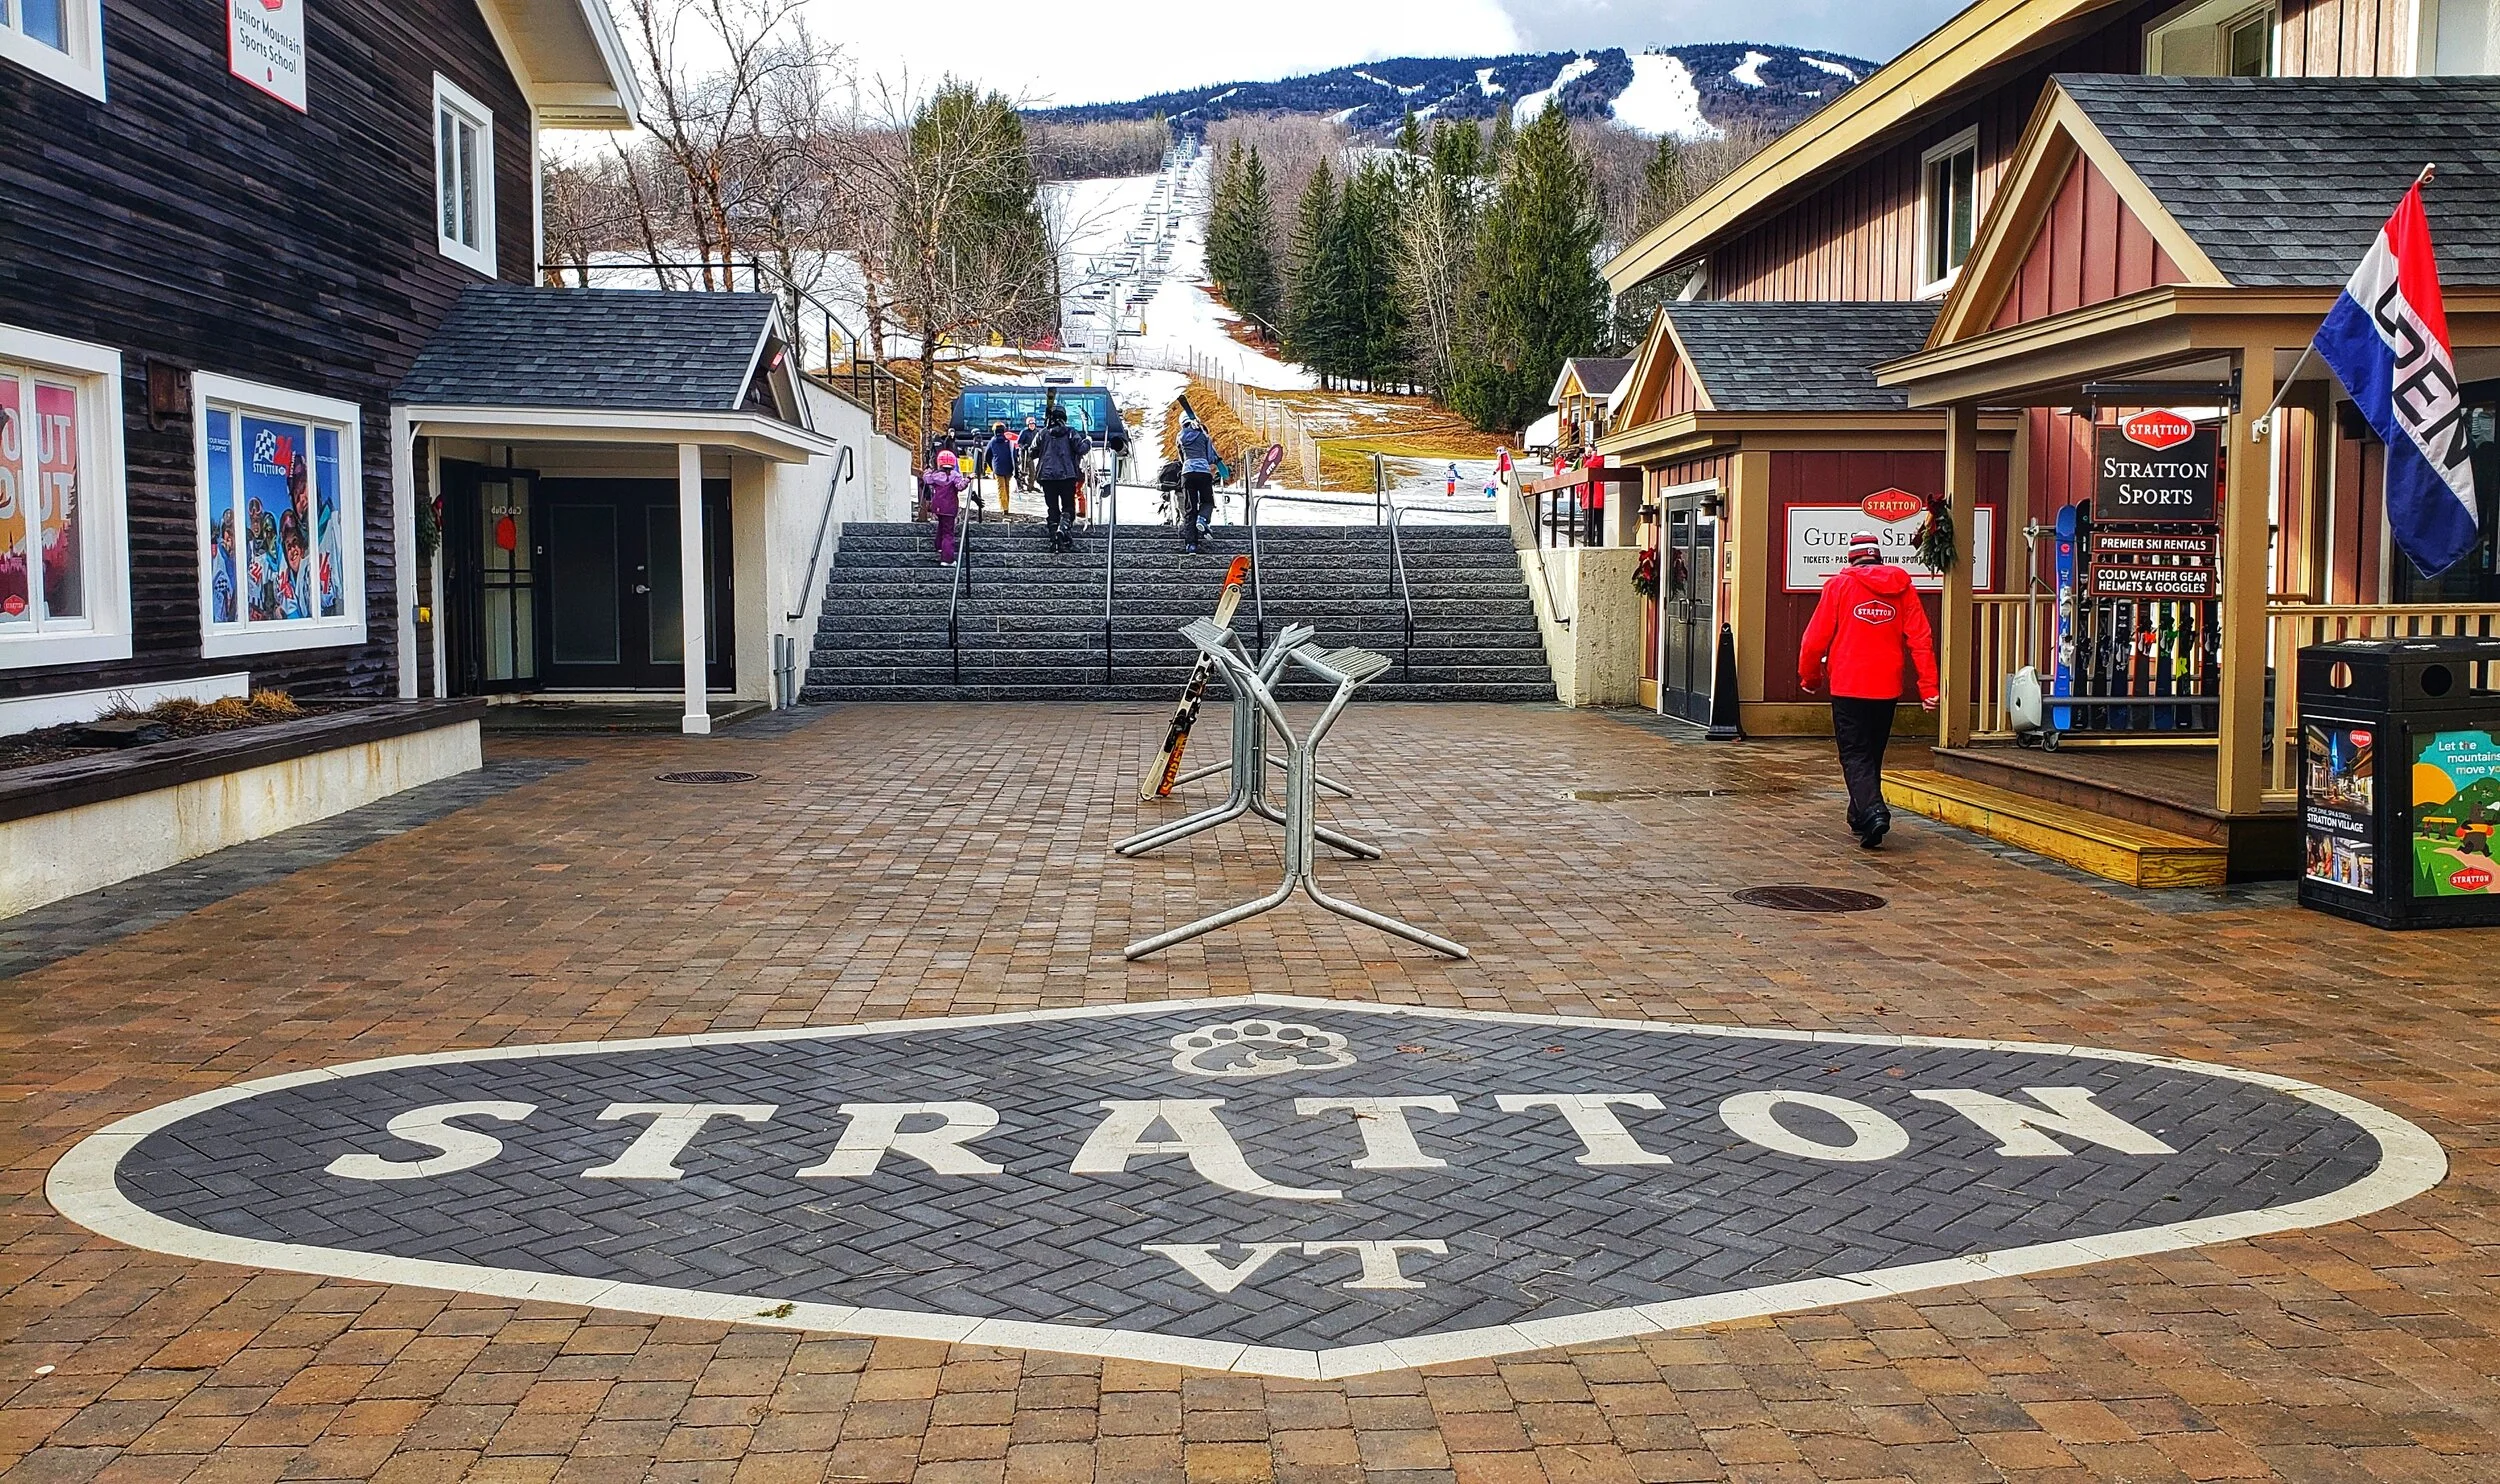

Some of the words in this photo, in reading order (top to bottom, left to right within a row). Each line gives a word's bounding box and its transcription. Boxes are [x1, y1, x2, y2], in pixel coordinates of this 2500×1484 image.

[234, 1, 260, 31] Junior
[262, 18, 301, 56] Mountain
[240, 27, 267, 57] Sports
[268, 45, 297, 74] School
[2129, 424, 2188, 438] STRATTON
[2103, 457, 2209, 479] STRATTON
[2118, 483, 2193, 505] SPORTS
[1867, 501, 1917, 513] STRATTON
[2101, 538, 2144, 549] PREMIER
[2146, 539, 2162, 550] SKI
[2164, 540, 2207, 551] RENTALS
[1803, 555, 1830, 564] TICKETS
[1901, 556, 1922, 564] SPORT
[2097, 569, 2128, 580] COLD
[2129, 570, 2177, 582] WEATHER
[2179, 572, 2208, 583] GEAR
[2098, 581, 2143, 592] HELMETS
[2145, 582, 2152, 592] &
[2155, 582, 2206, 593] GOGGLES
[1857, 607, 1893, 618] STRATTON
[2438, 741, 2456, 751] Let
[2459, 741, 2477, 750] the
[2447, 751, 2500, 763] mountains
[2456, 766, 2485, 774] move
[2307, 813, 2337, 827] STRATTON
[2337, 819, 2364, 833] VILLAGE
[2452, 874, 2490, 886] STRATTON
[324, 1086, 2179, 1202] STRATTON
[1140, 1239, 1449, 1294] VT
